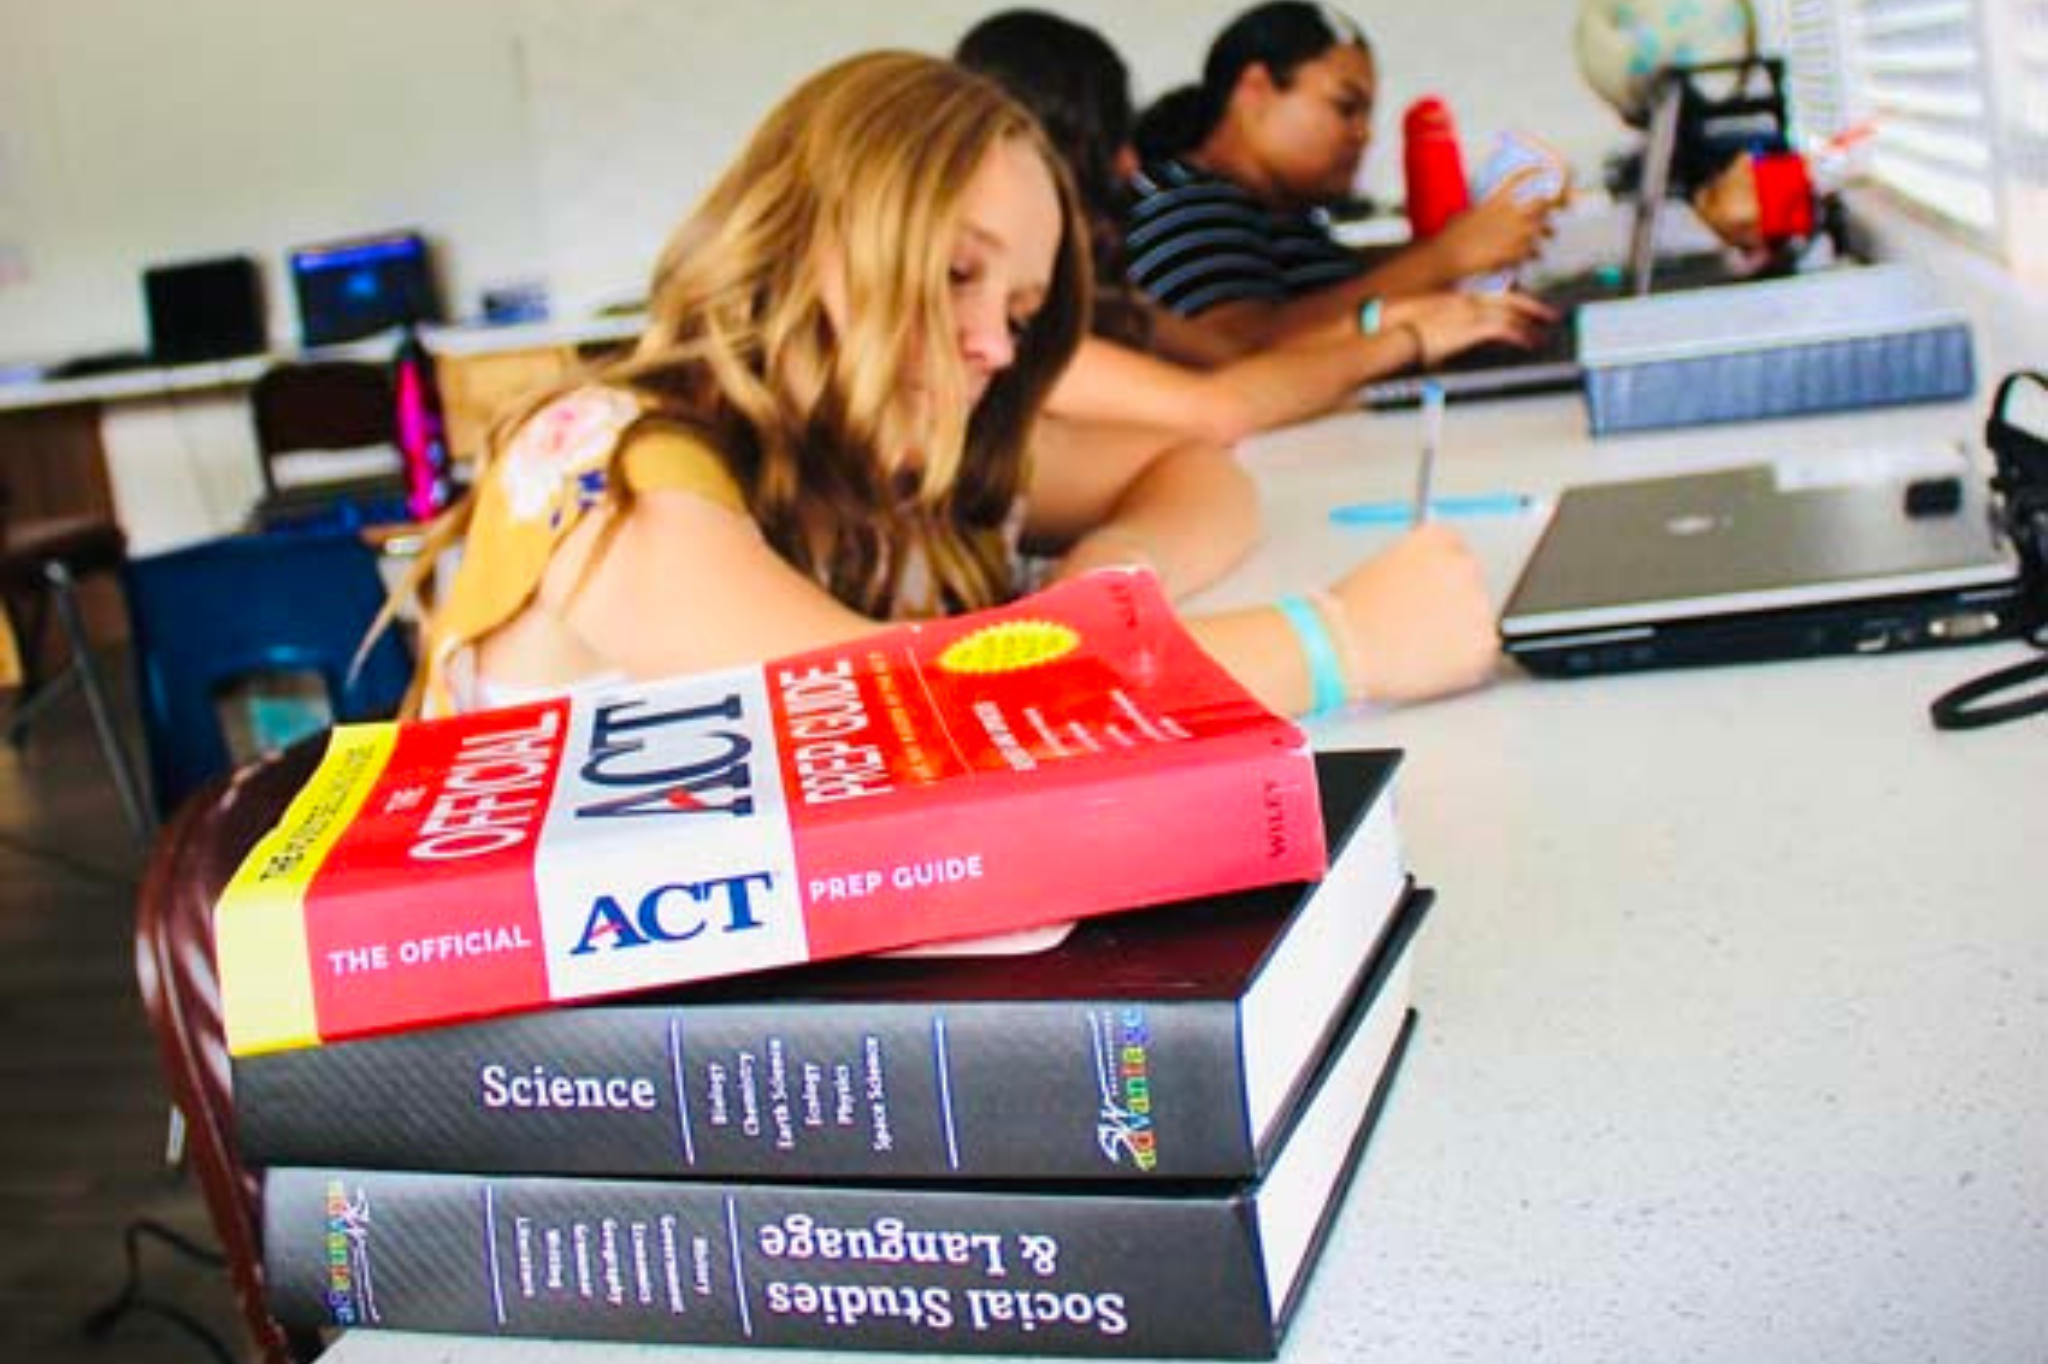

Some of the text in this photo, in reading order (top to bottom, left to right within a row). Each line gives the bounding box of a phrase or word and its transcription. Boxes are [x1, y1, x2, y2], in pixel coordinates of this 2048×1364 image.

[576, 693, 753, 818] ACT
[779, 660, 894, 805] PREP GUIDE
[409, 711, 561, 861] OFFICIAL
[1269, 780, 1287, 859] WILEY
[569, 871, 773, 957] ACT
[809, 855, 983, 902] PREP GUIDE
[328, 924, 531, 976] THE OFFICIAL
[482, 1064, 656, 1109] Science
[710, 1063, 727, 1125] Biology
[738, 1052, 759, 1136] Chemistry
[769, 1039, 795, 1149] Earth Science
[802, 1063, 822, 1126] Ecology
[835, 1065, 855, 1125] Physics
[866, 1036, 892, 1151] Space Science
[761, 1214, 1058, 1276] & Language
[769, 1282, 1127, 1335] Social Studies
